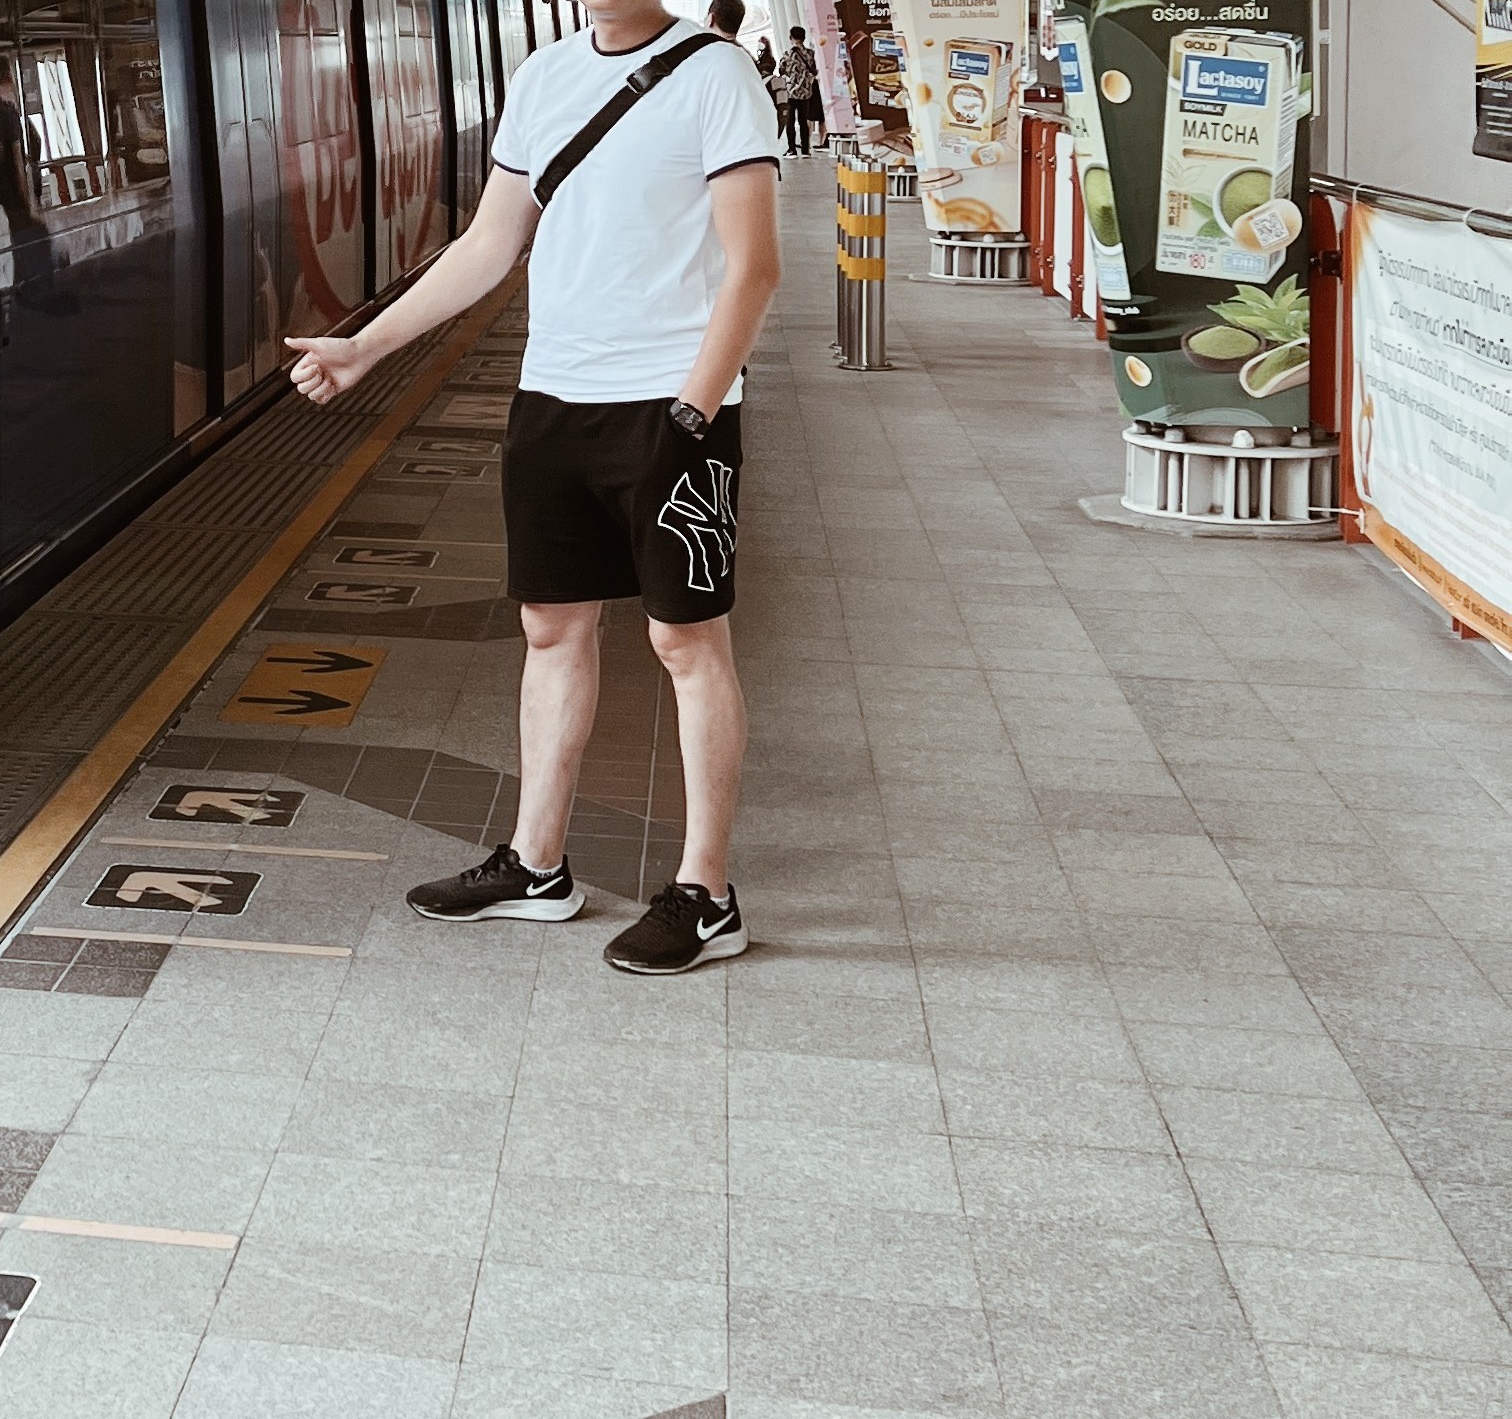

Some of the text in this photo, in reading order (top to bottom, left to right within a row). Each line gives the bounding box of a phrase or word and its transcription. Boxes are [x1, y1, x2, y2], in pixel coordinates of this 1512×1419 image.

[1183, 40, 1218, 52] GOLD
[1185, 60, 1266, 97] Lactasoy
[1182, 119, 1260, 146] MATCHA
